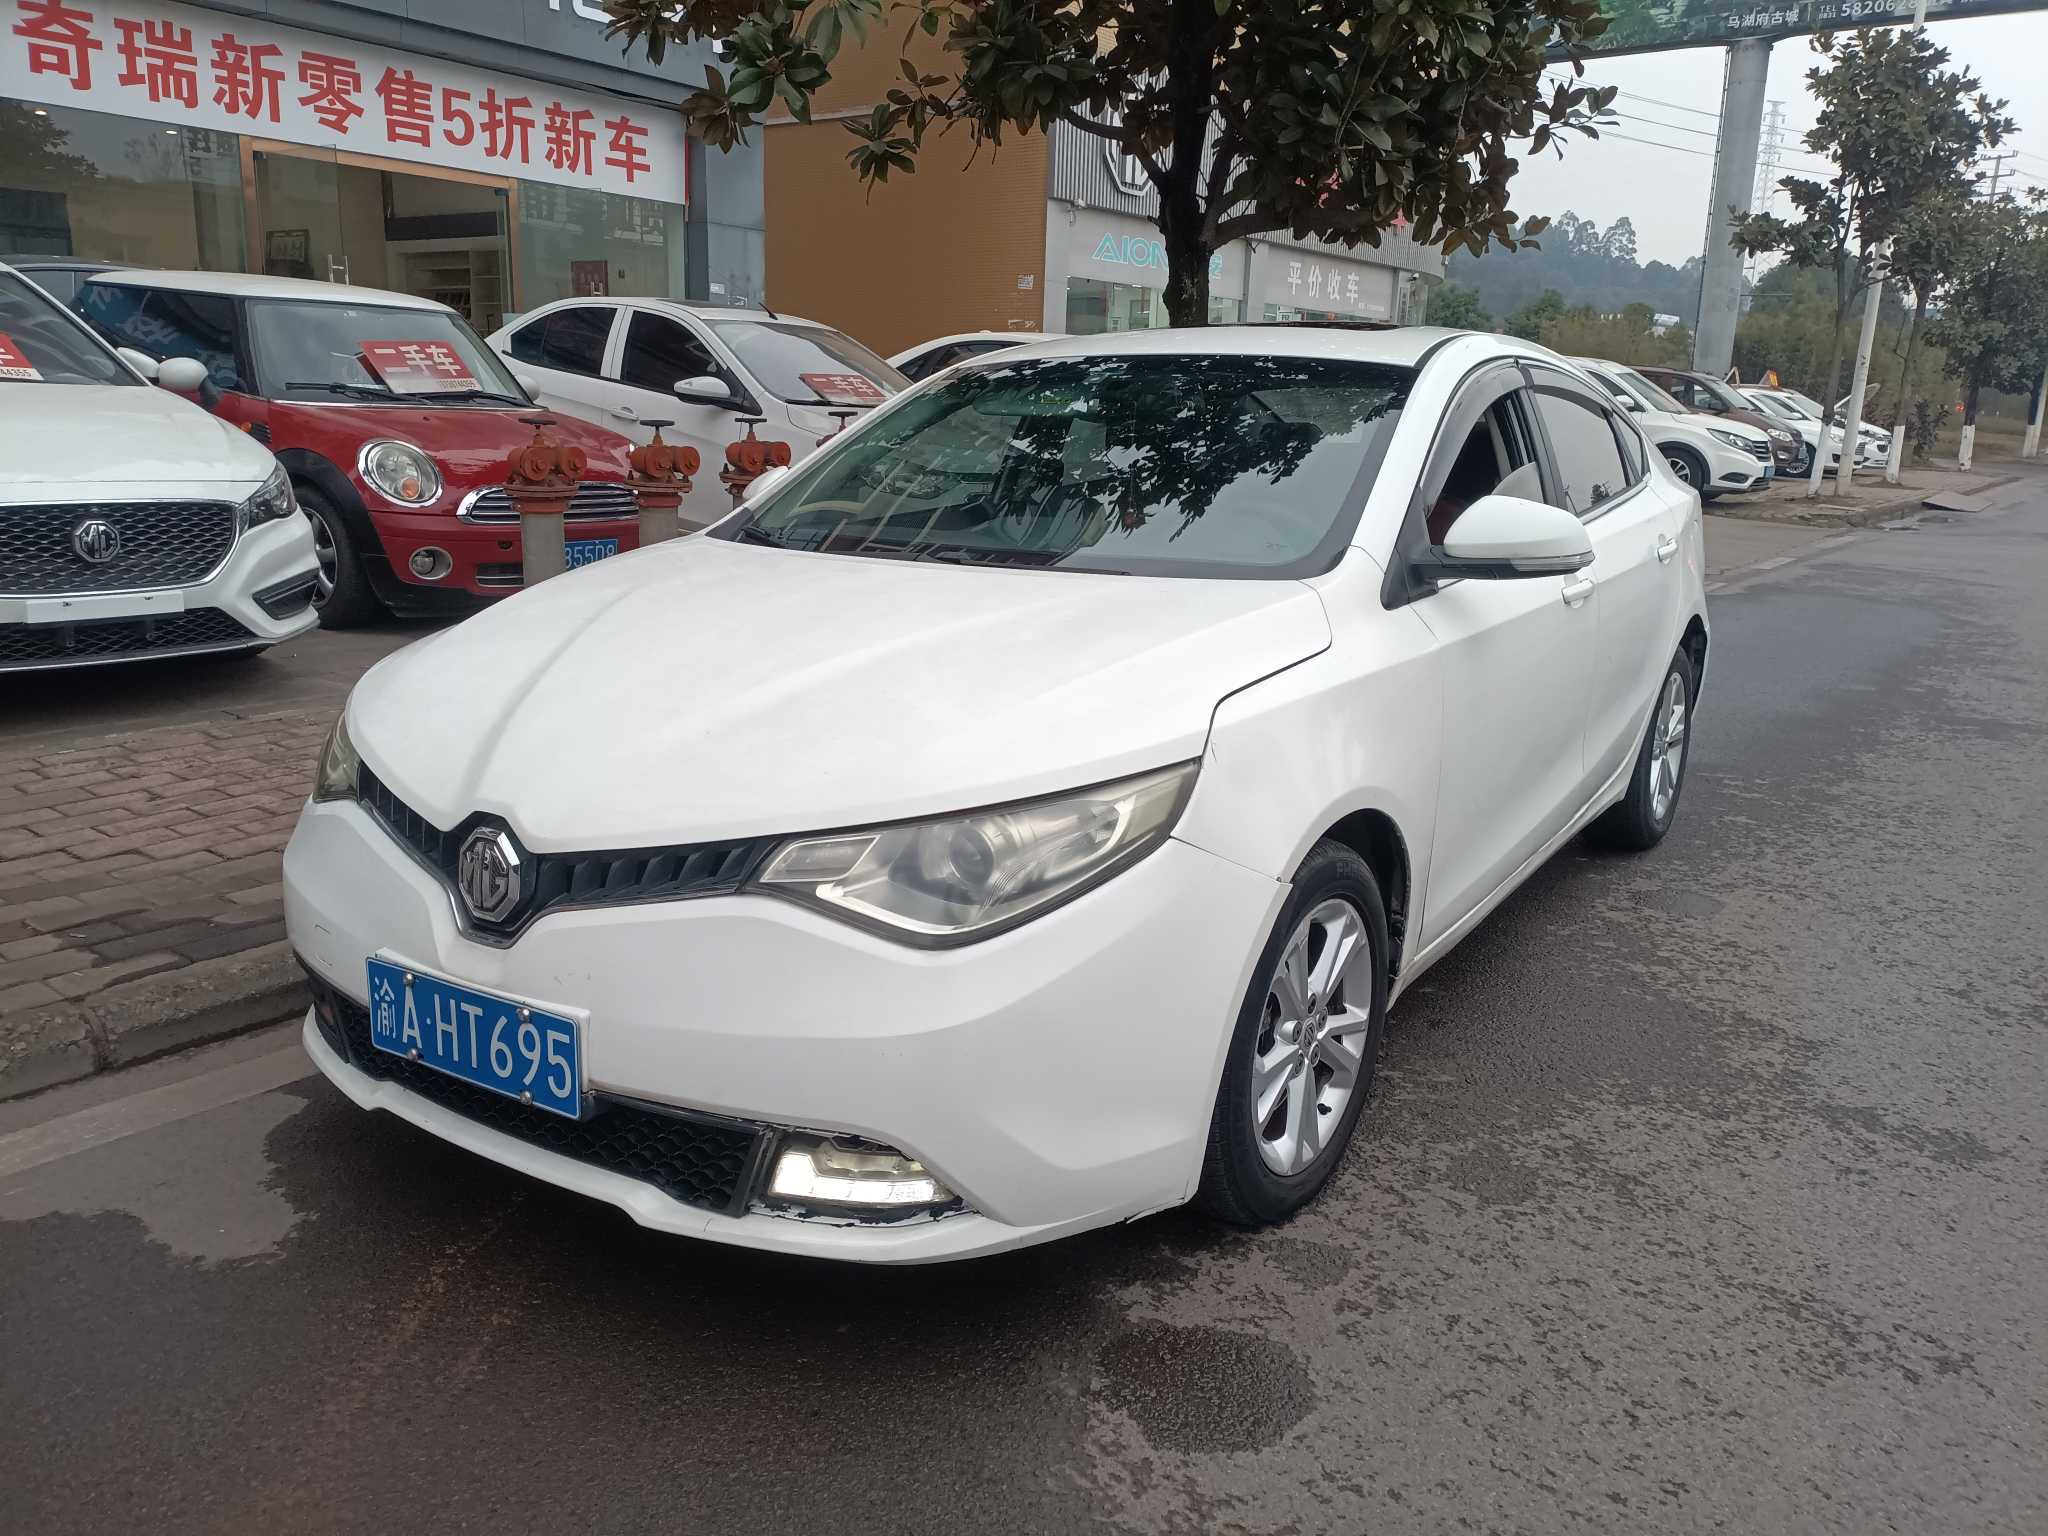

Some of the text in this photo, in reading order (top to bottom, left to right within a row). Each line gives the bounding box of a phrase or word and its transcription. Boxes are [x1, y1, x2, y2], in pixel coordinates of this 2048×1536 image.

[12, 0, 651, 183] 奇瑞新零售5折新车
[1287, 261, 1360, 304] 平价收车
[373, 344, 462, 377] 二手车
[812, 376, 875, 396] 二手车
